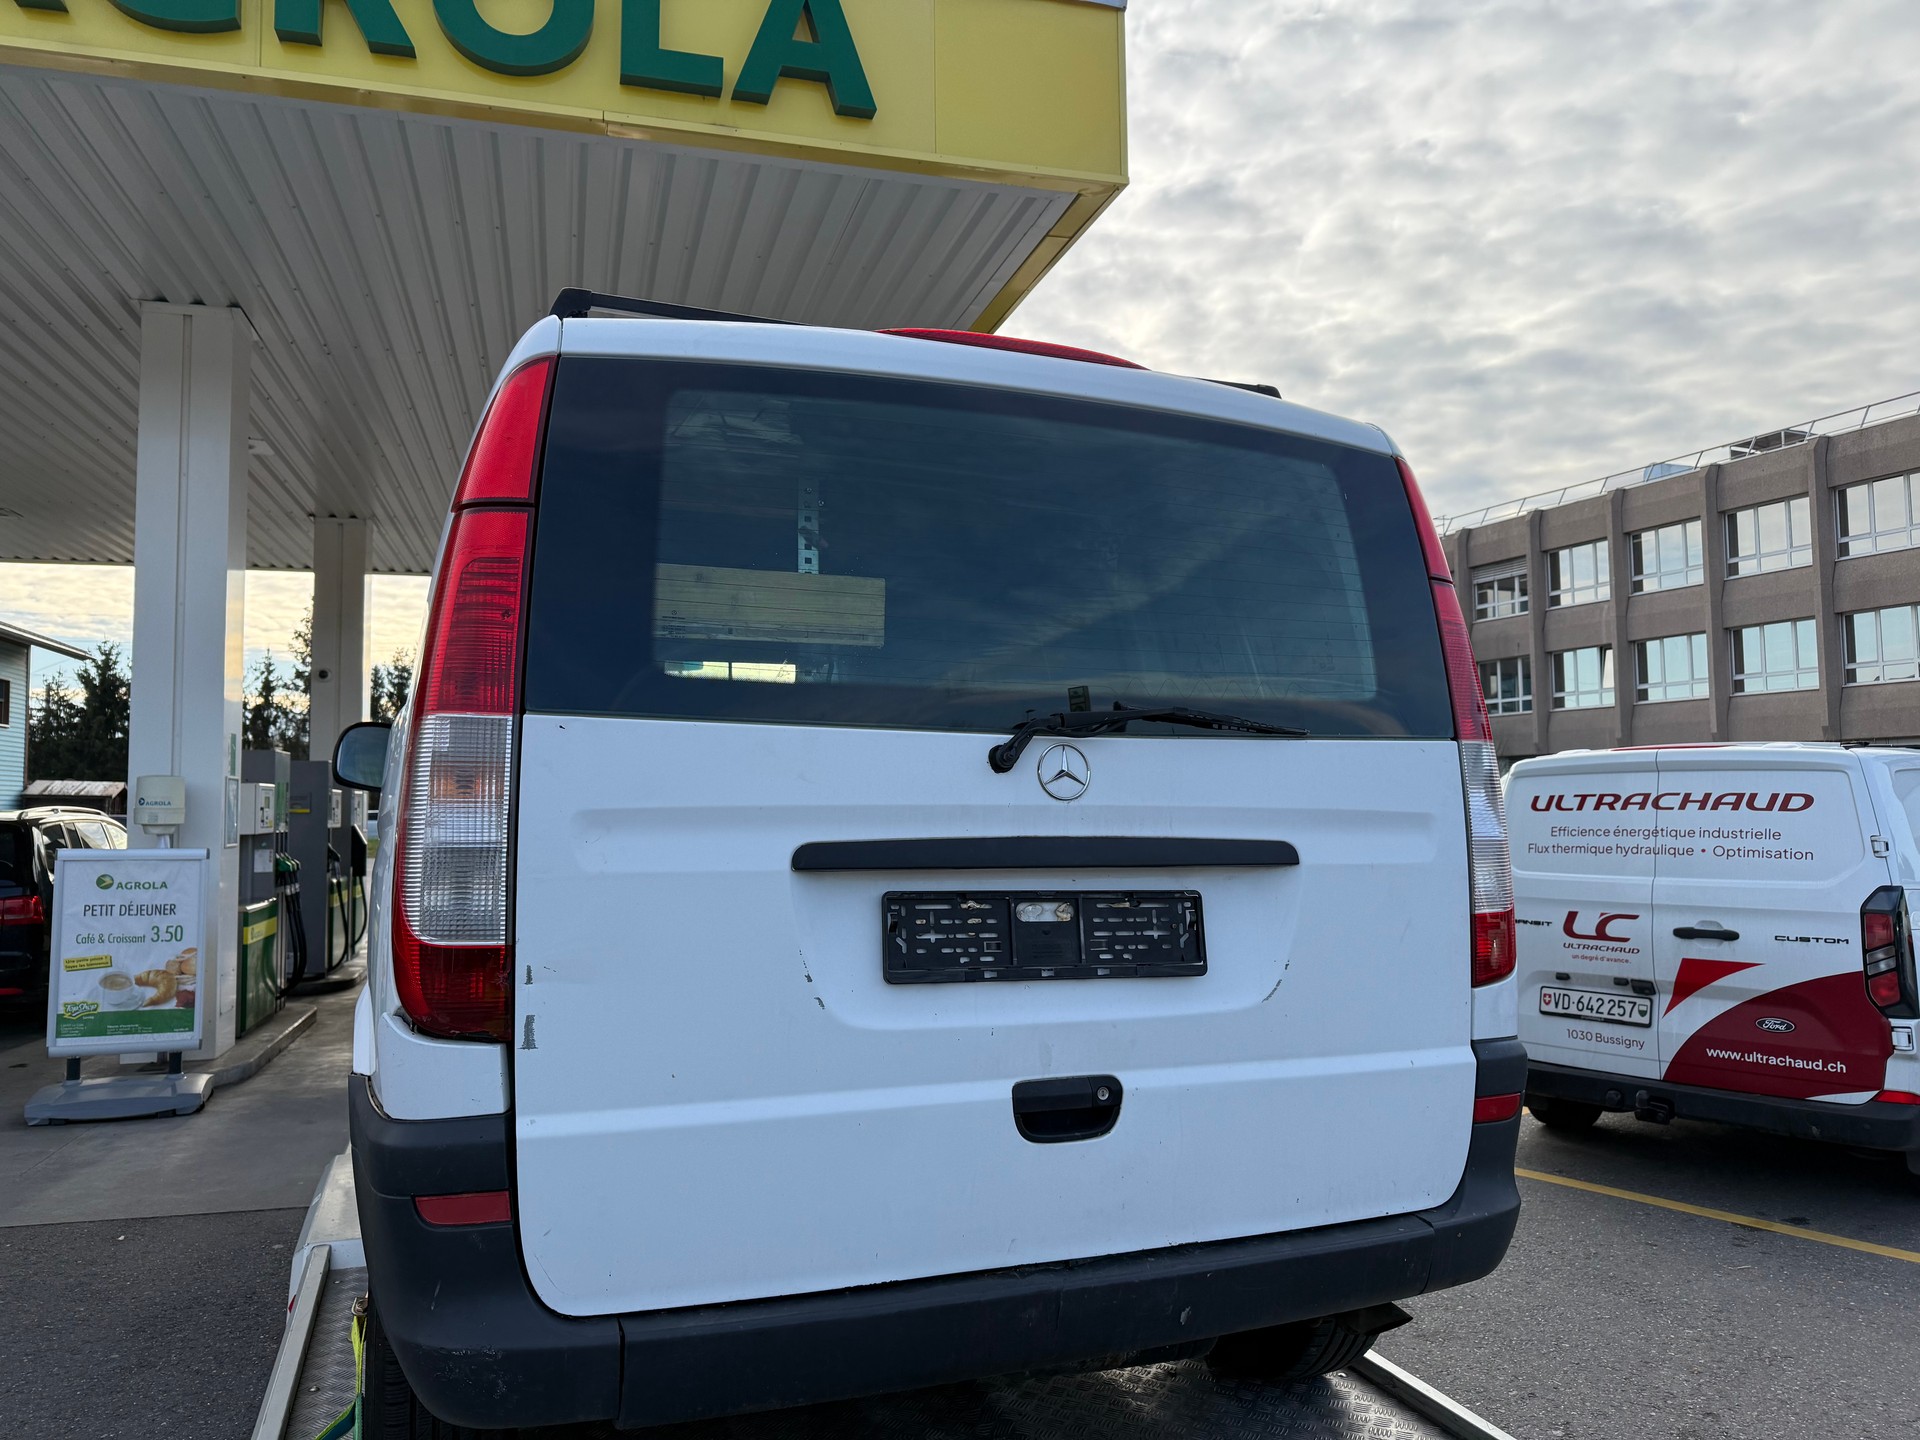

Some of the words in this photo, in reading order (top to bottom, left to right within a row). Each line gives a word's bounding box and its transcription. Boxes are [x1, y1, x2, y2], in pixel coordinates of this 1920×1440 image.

[14, 0, 877, 119] OLA
[1530, 792, 1815, 812] ULTRACHAUD
[1550, 826, 1611, 839] Efficience
[1613, 825, 1696, 843] énergétique
[1698, 827, 1782, 841] industrielle
[1527, 843, 1550, 854] Flux
[1551, 843, 1613, 858] thermique
[1615, 843, 1695, 858] hydraulique
[1712, 845, 1814, 861] Optimisation
[115, 881, 168, 891] AGROLA
[83, 904, 116, 917] PETIT
[118, 901, 177, 917] DÉJEUNER
[75, 933, 96, 945] Café
[97, 934, 105, 944] &
[107, 933, 146, 944] Croissant
[150, 925, 184, 943] 3.50
[1774, 935, 1849, 944] CUSTOM
[1563, 942, 1640, 954] ULTRACHAUD
[1762, 1019, 1787, 1031] Ford
[1567, 1029, 1593, 1041] 1030
[1595, 1032, 1645, 1050] Bussigny
[1706, 1048, 1847, 1073] www.ultrachaud.ch
